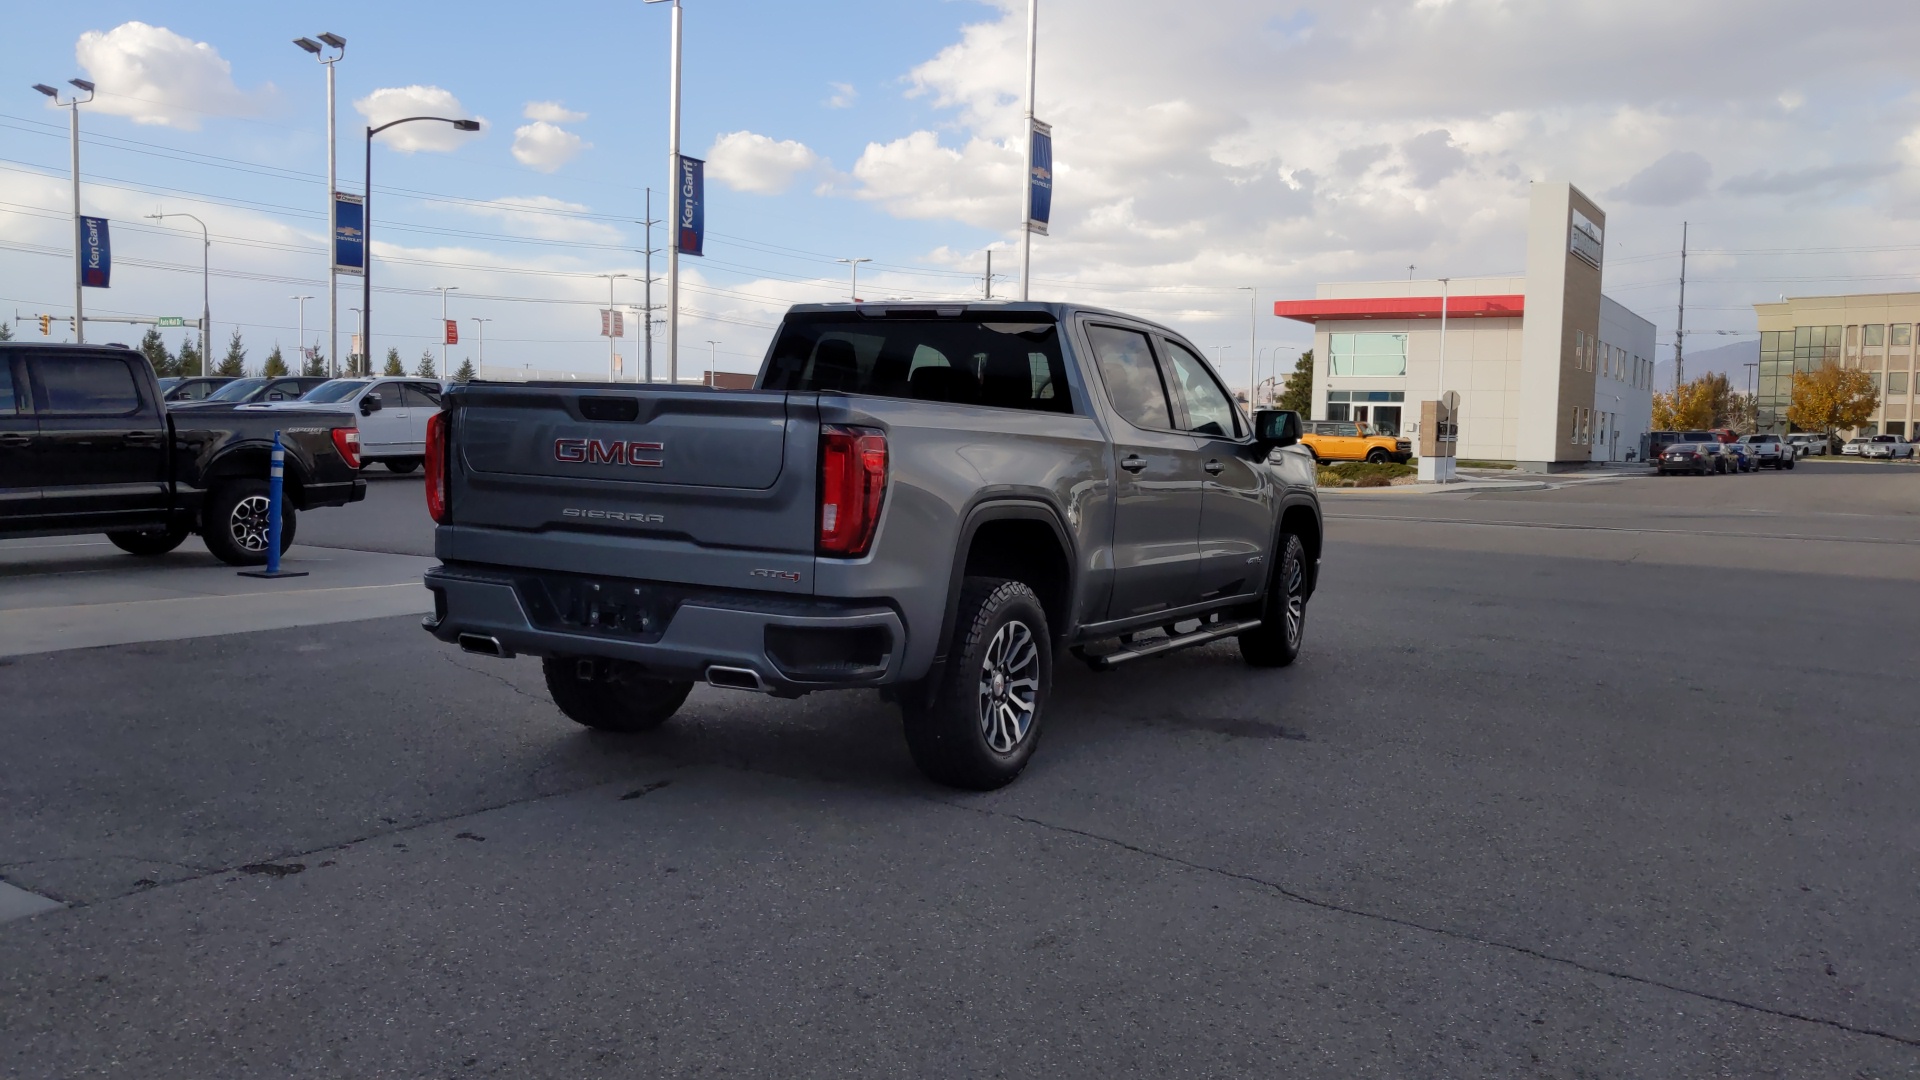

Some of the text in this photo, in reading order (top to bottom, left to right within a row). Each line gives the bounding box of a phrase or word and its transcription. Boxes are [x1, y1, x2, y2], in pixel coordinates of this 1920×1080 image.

[682, 159, 694, 228] Ken Garff
[86, 219, 99, 268] Ken Garff
[554, 438, 664, 467] GMC
[562, 507, 664, 523] SIERRA
[750, 568, 801, 583] AT4
